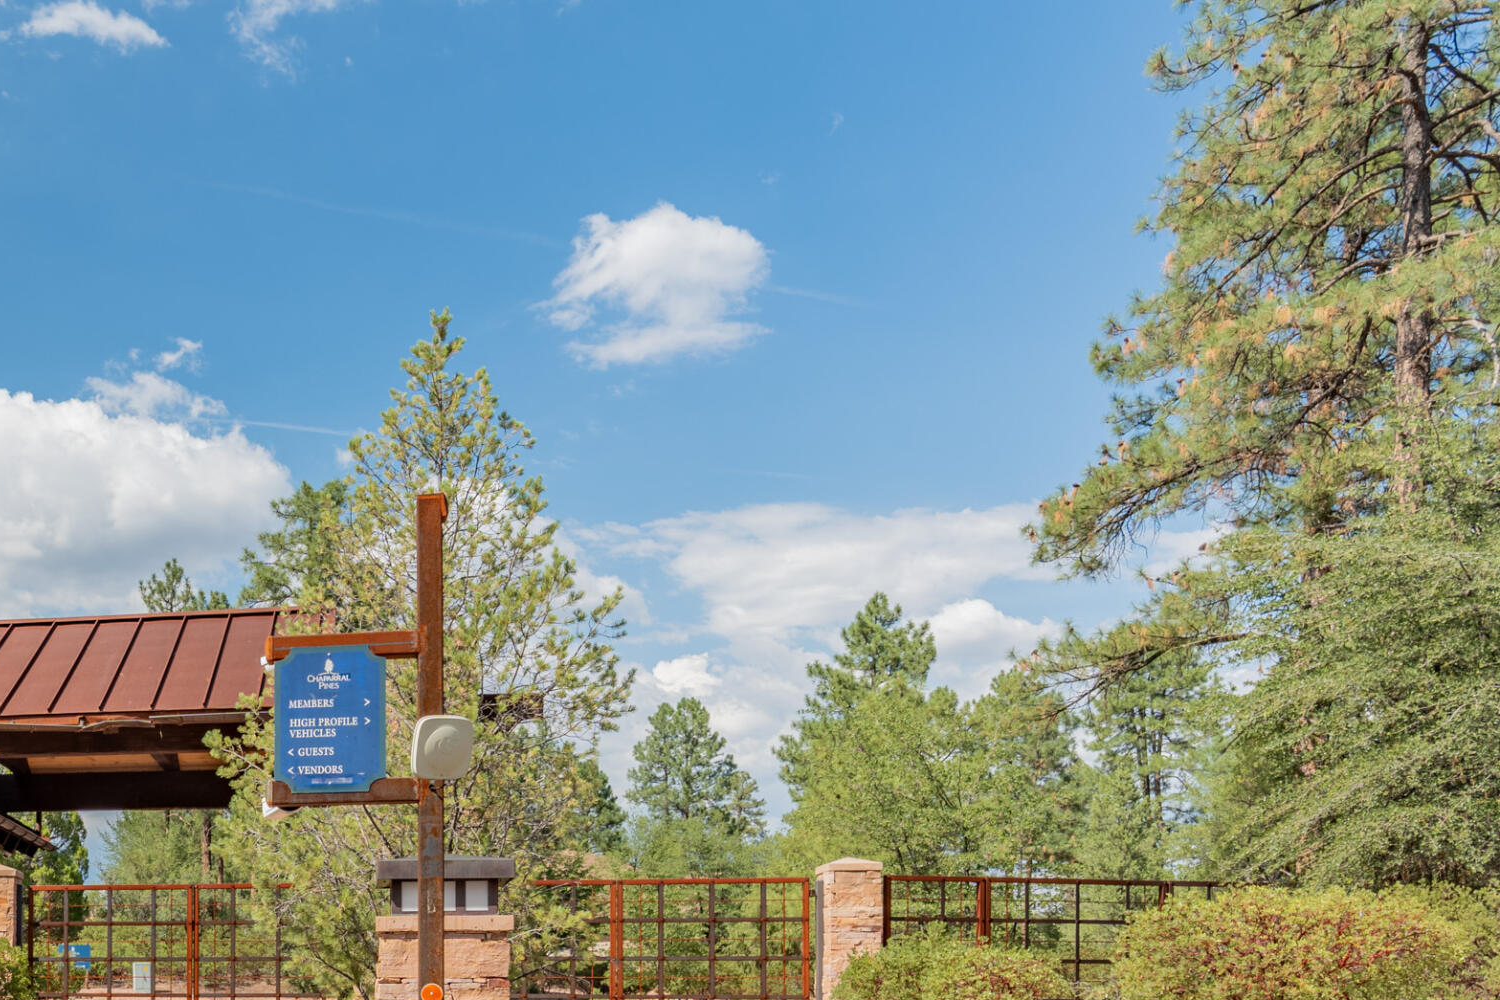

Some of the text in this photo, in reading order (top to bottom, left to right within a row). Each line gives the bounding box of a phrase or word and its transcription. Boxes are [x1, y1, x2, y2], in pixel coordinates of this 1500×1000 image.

[318, 682, 339, 690] PINES
[288, 699, 334, 709] MEMBERS
[289, 716, 358, 728] HIGH PROFILE
[289, 728, 337, 738] VEHICLES
[297, 746, 335, 757] GUESTS
[298, 765, 343, 775] VENDORS
